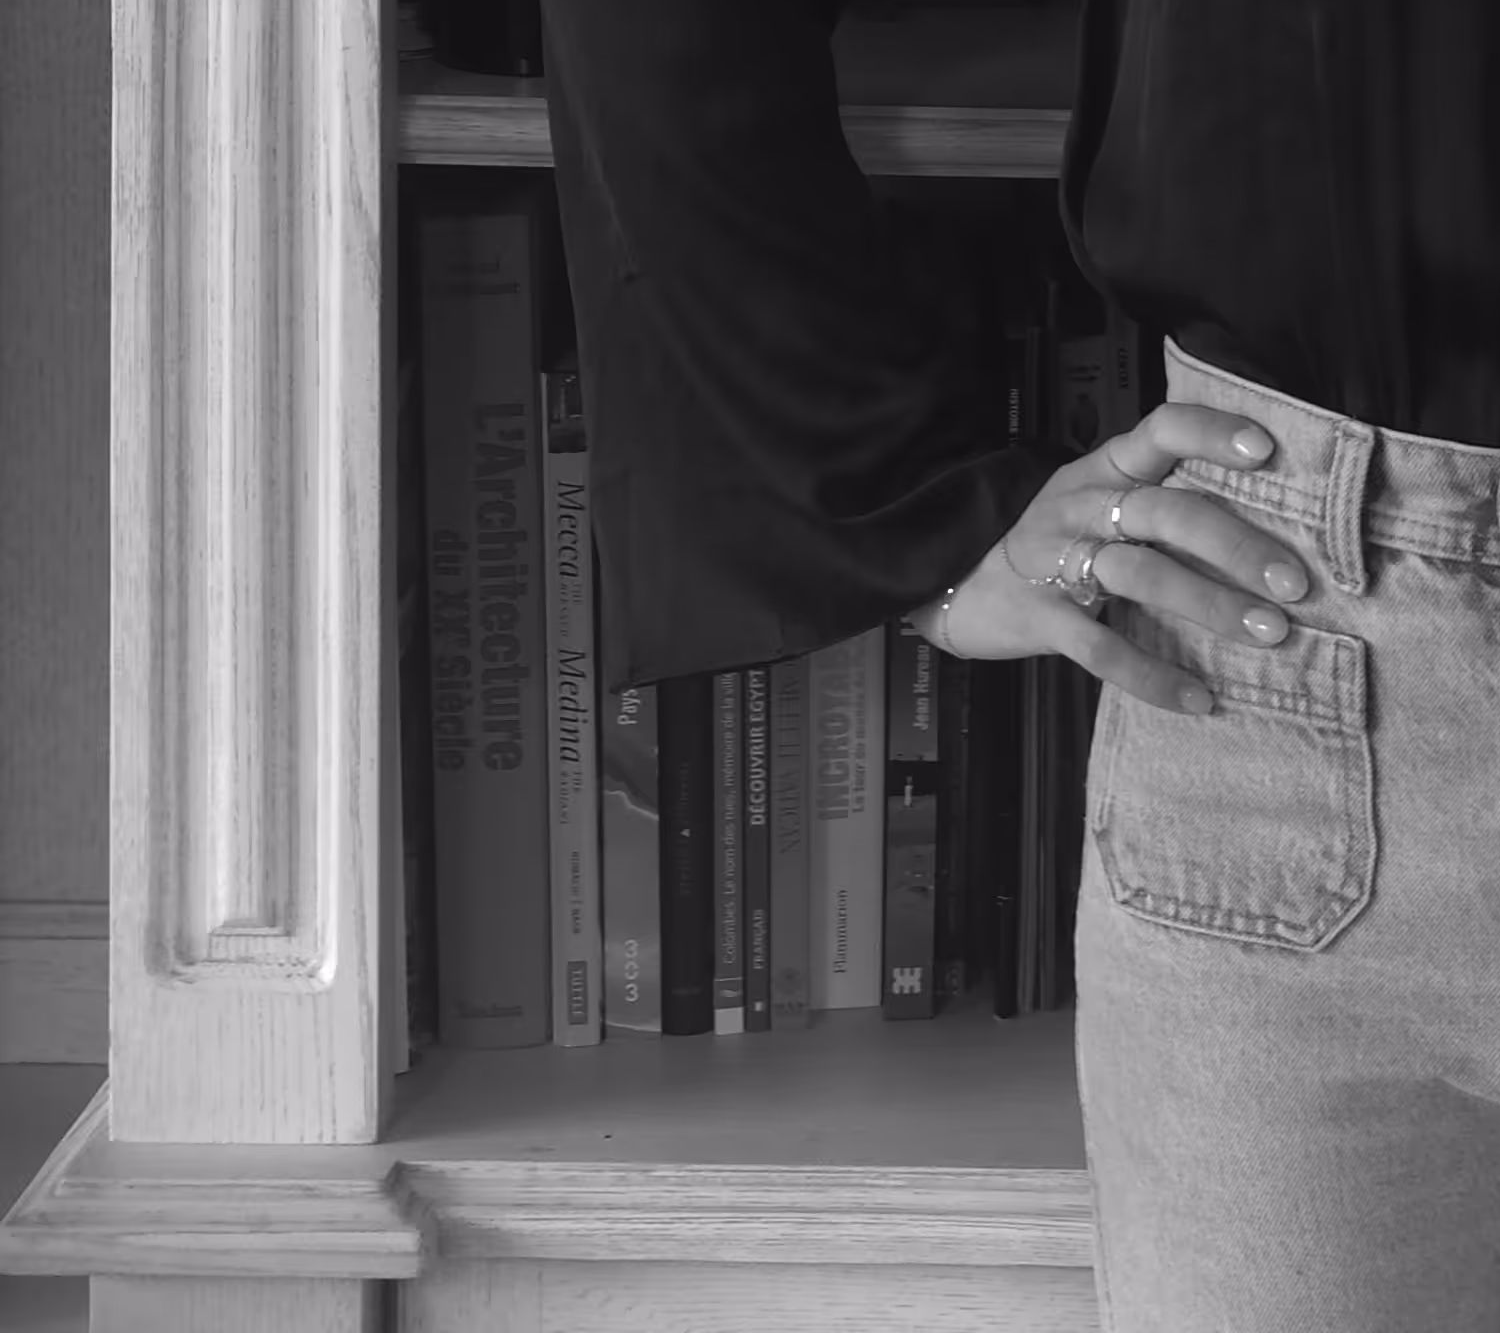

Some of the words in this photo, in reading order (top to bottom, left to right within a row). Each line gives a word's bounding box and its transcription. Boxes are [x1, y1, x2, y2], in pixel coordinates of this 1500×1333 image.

[433, 529, 470, 575] du
[557, 478, 587, 579] Mecca
[474, 402, 530, 772] L'Architecture
[433, 655, 470, 772] siècle
[557, 647, 588, 764] Medina
[616, 689, 641, 726] Pays
[719, 697, 736, 710] la
[719, 712, 736, 729] de
[912, 696, 930, 731] Jean
[748, 726, 766, 826] DÉCOUVRIR
